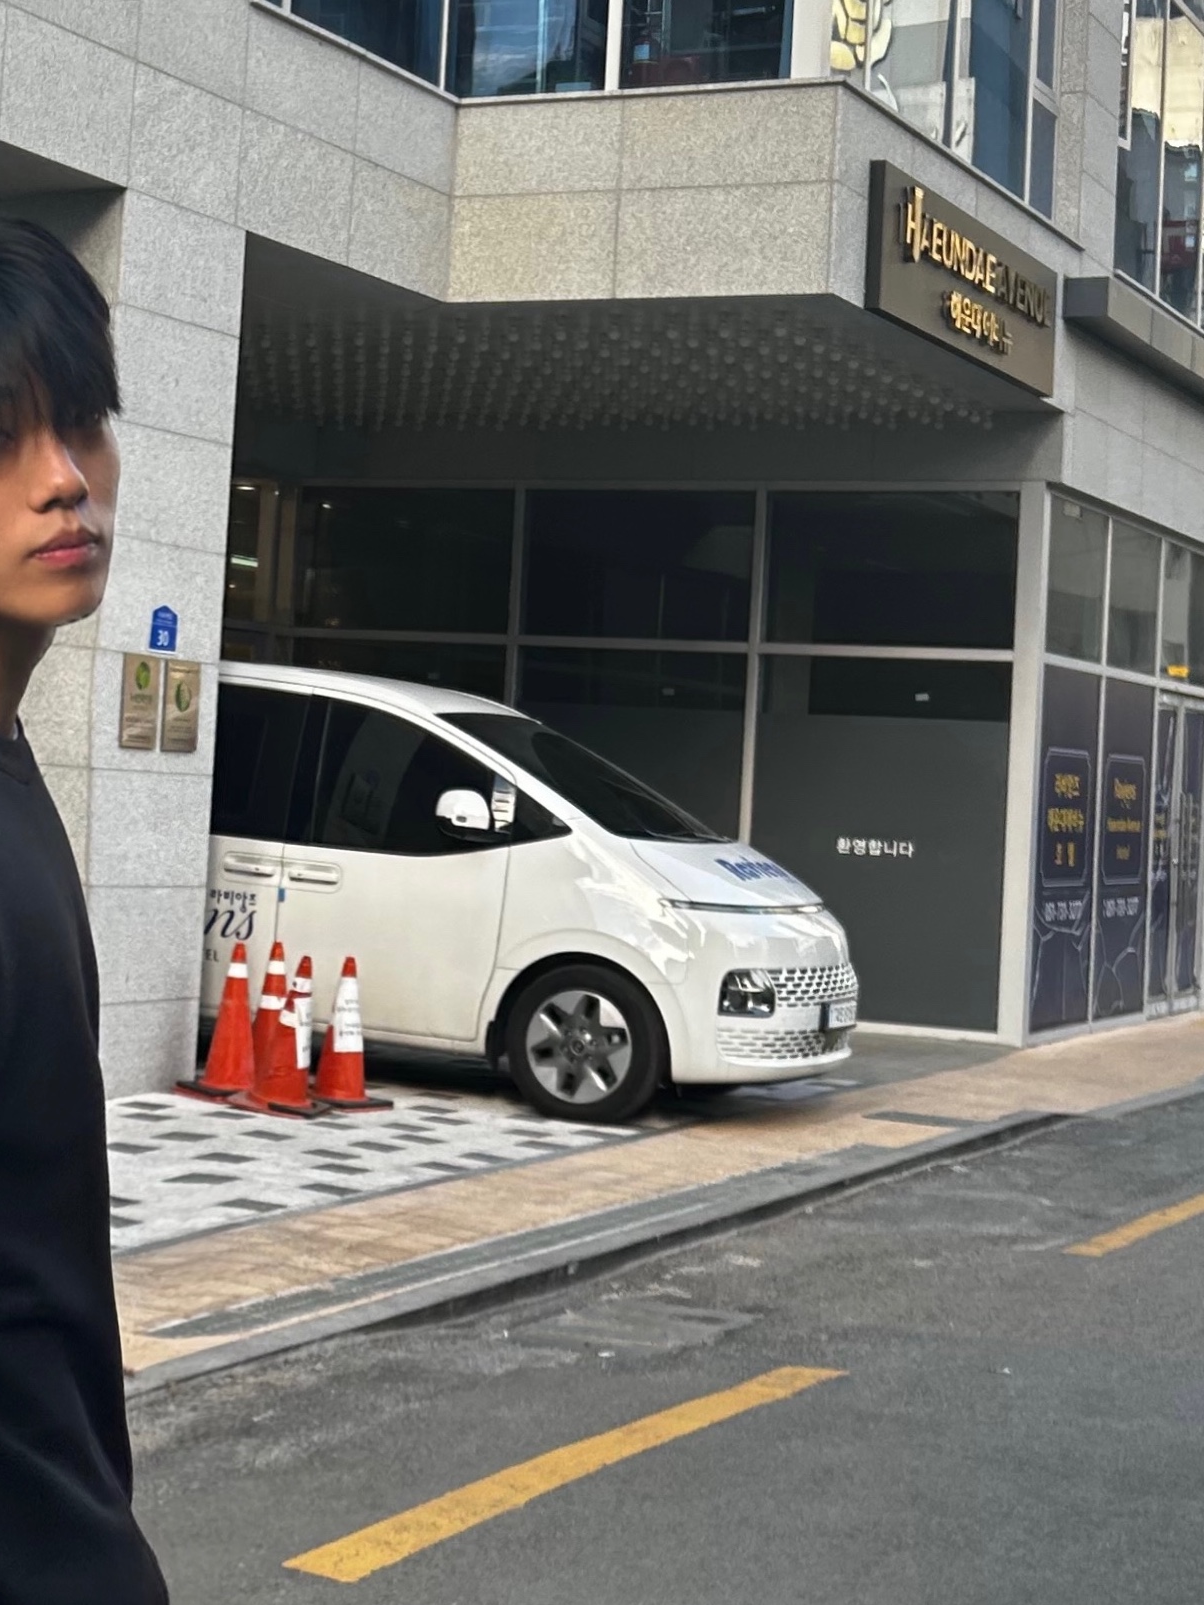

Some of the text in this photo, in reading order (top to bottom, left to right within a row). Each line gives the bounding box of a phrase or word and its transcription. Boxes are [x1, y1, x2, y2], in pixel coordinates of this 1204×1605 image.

[905, 186, 996, 294] HAEUNDAE
[156, 629, 170, 647] 30
[836, 836, 915, 858] 환영합니다
